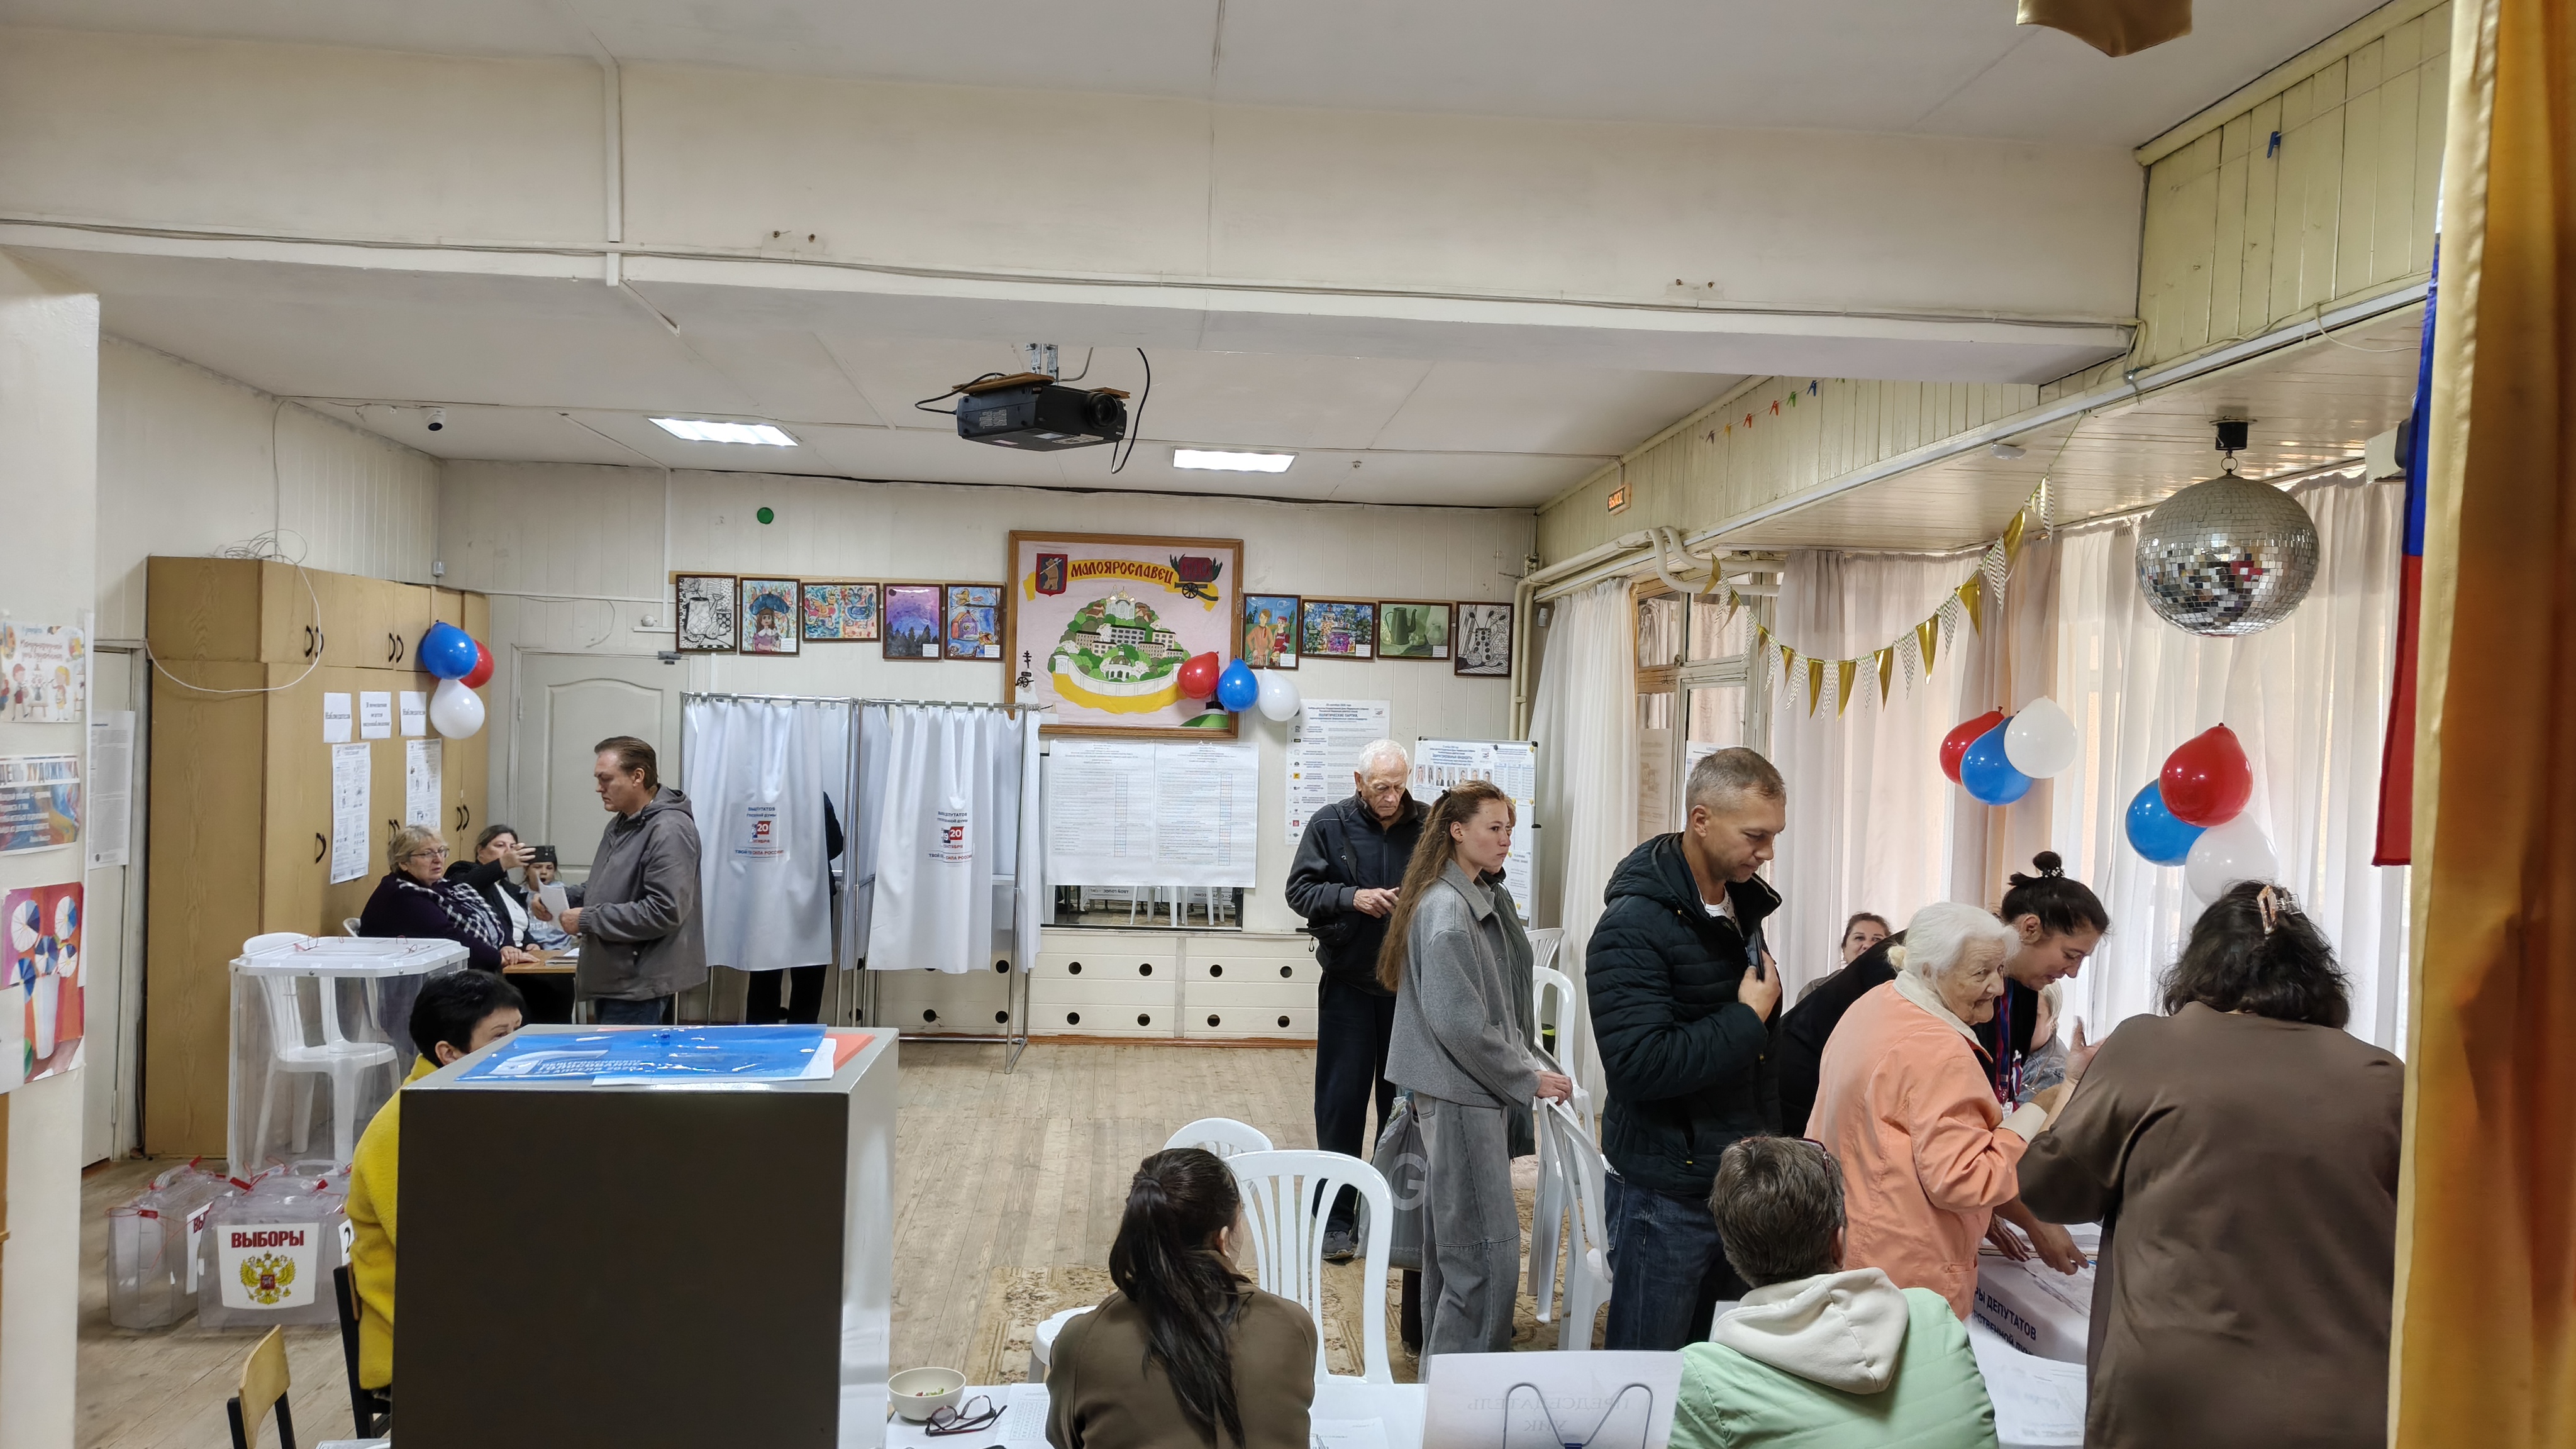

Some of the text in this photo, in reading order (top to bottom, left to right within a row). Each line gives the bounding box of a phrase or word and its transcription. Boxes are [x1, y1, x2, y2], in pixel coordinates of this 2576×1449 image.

[1071, 561, 1174, 584] МАЛОЯРОСЛАВЕЦ
[231, 1230, 304, 1248] ВЫБОРЫ
[1987, 1294, 2036, 1341] ДЕПУТАТОВ
